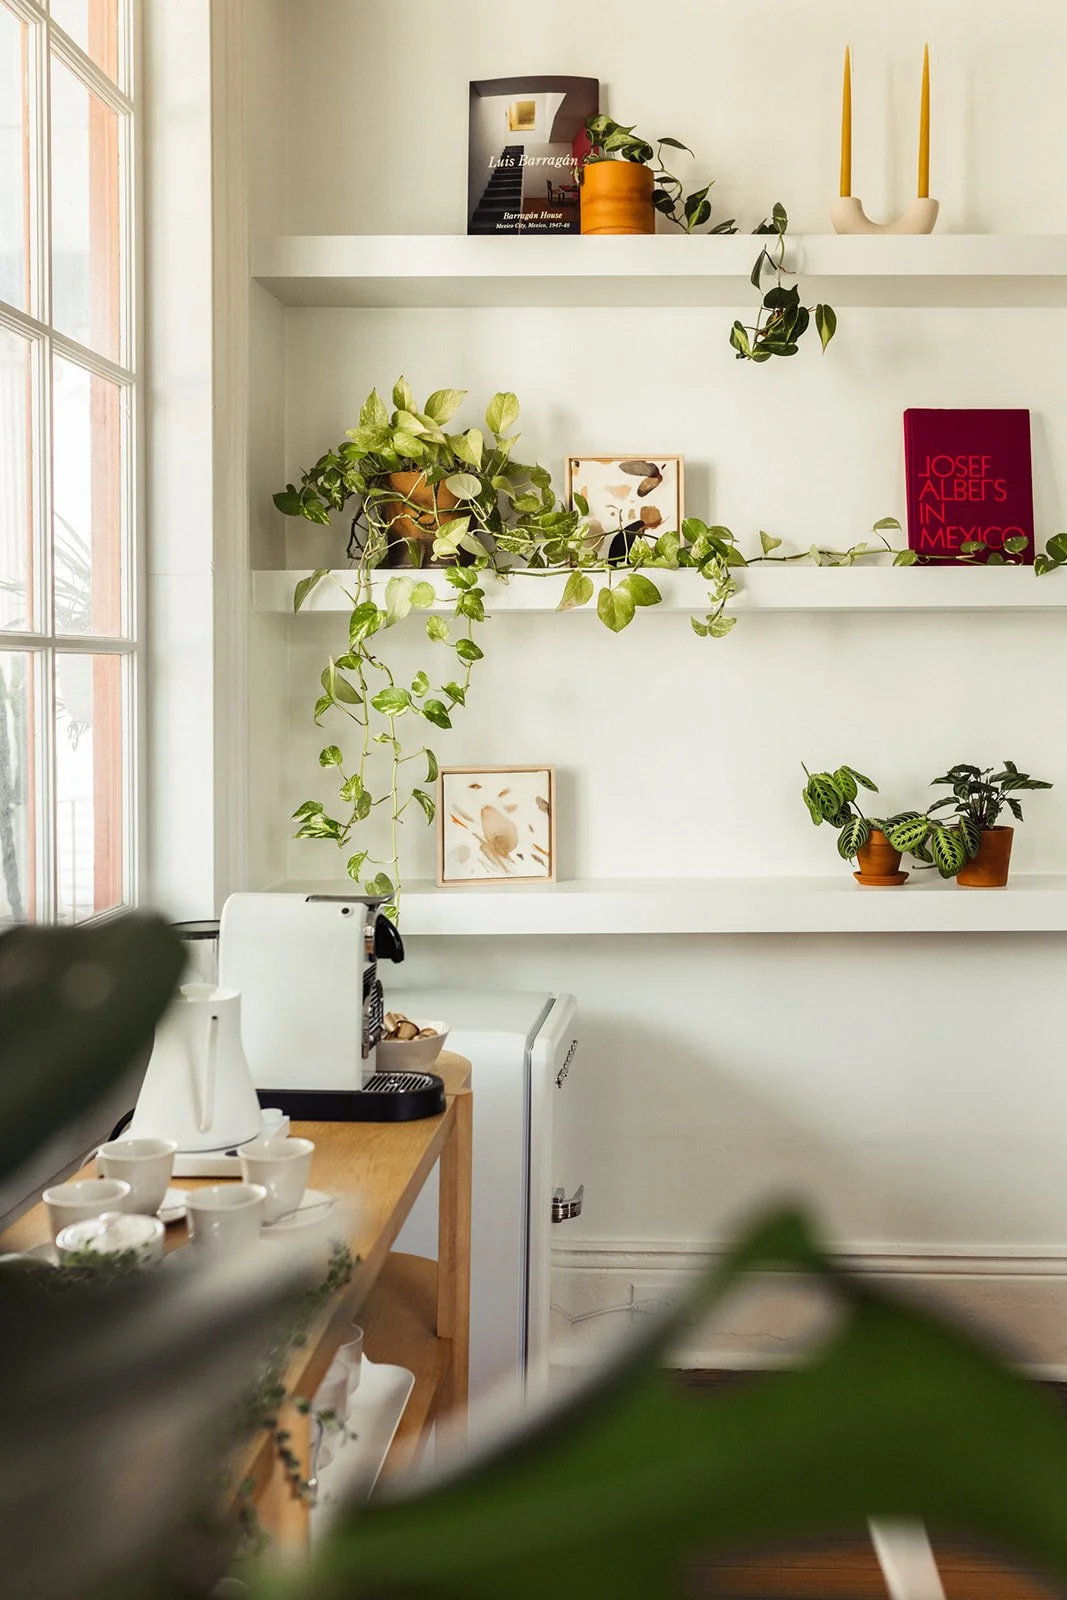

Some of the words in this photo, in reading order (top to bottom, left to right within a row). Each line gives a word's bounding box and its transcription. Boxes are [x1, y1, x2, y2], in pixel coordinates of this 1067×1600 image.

[488, 155, 515, 168] Luis
[518, 153, 578, 168] Barragán
[503, 211, 539, 220] Barragán
[540, 211, 563, 219] House
[918, 455, 992, 478] JOSEF
[919, 503, 945, 524] IN
